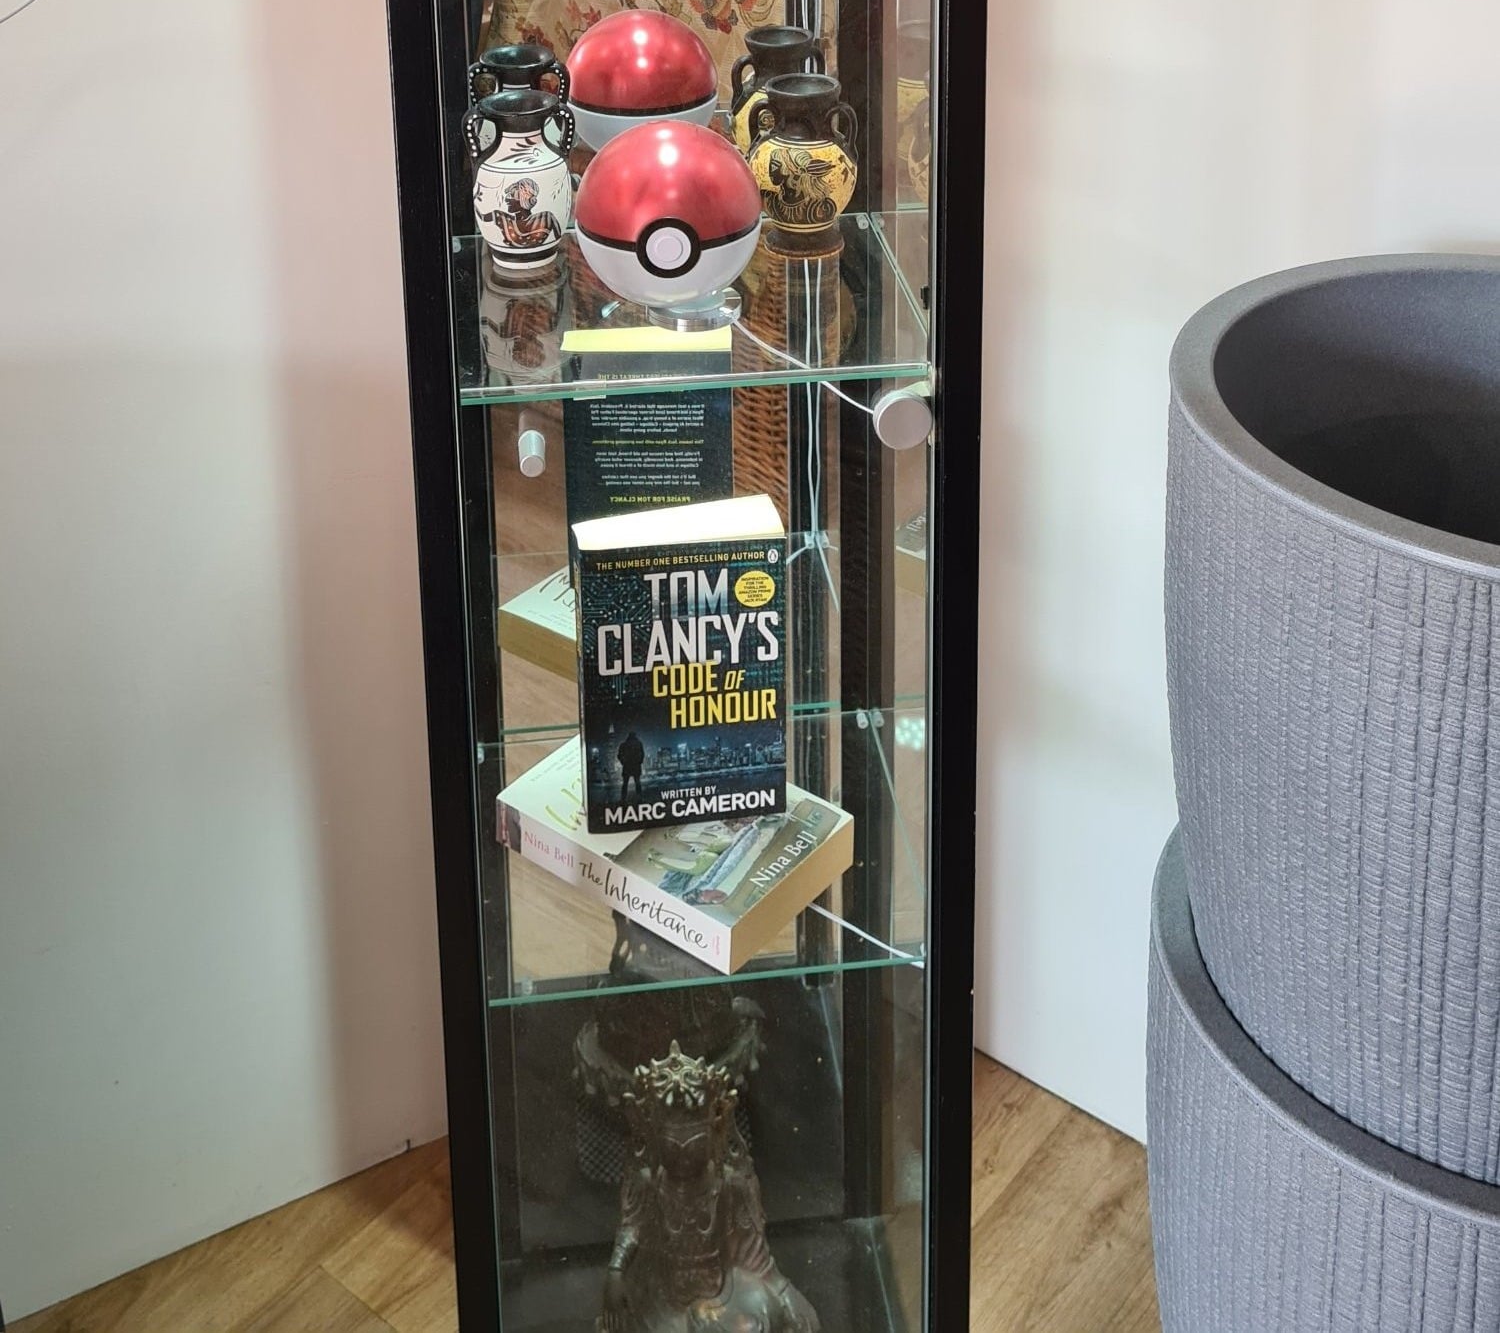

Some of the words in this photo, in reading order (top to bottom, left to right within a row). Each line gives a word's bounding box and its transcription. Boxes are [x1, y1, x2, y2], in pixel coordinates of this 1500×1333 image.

[597, 562, 612, 571] THE
[616, 559, 651, 569] NUMBER
[654, 557, 670, 566] ONE
[673, 553, 729, 564] BESTSELLING
[732, 551, 765, 560] AUTHOR
[644, 568, 727, 620] TOM
[598, 611, 778, 676] CLANCY'S
[653, 660, 718, 697] CODE
[724, 670, 746, 690] OF
[671, 689, 776, 729] HONOUR
[605, 802, 666, 825] MARC
[672, 789, 775, 817] CAMERON
[661, 787, 702, 800] WRITTEN
[705, 785, 716, 795] BY
[750, 856, 791, 887] Nina
[784, 831, 817, 856] Bell
[524, 831, 550, 855] Nina
[554, 845, 574, 868] Bell
[579, 861, 602, 886] The
[604, 869, 708, 949] Inheritance
